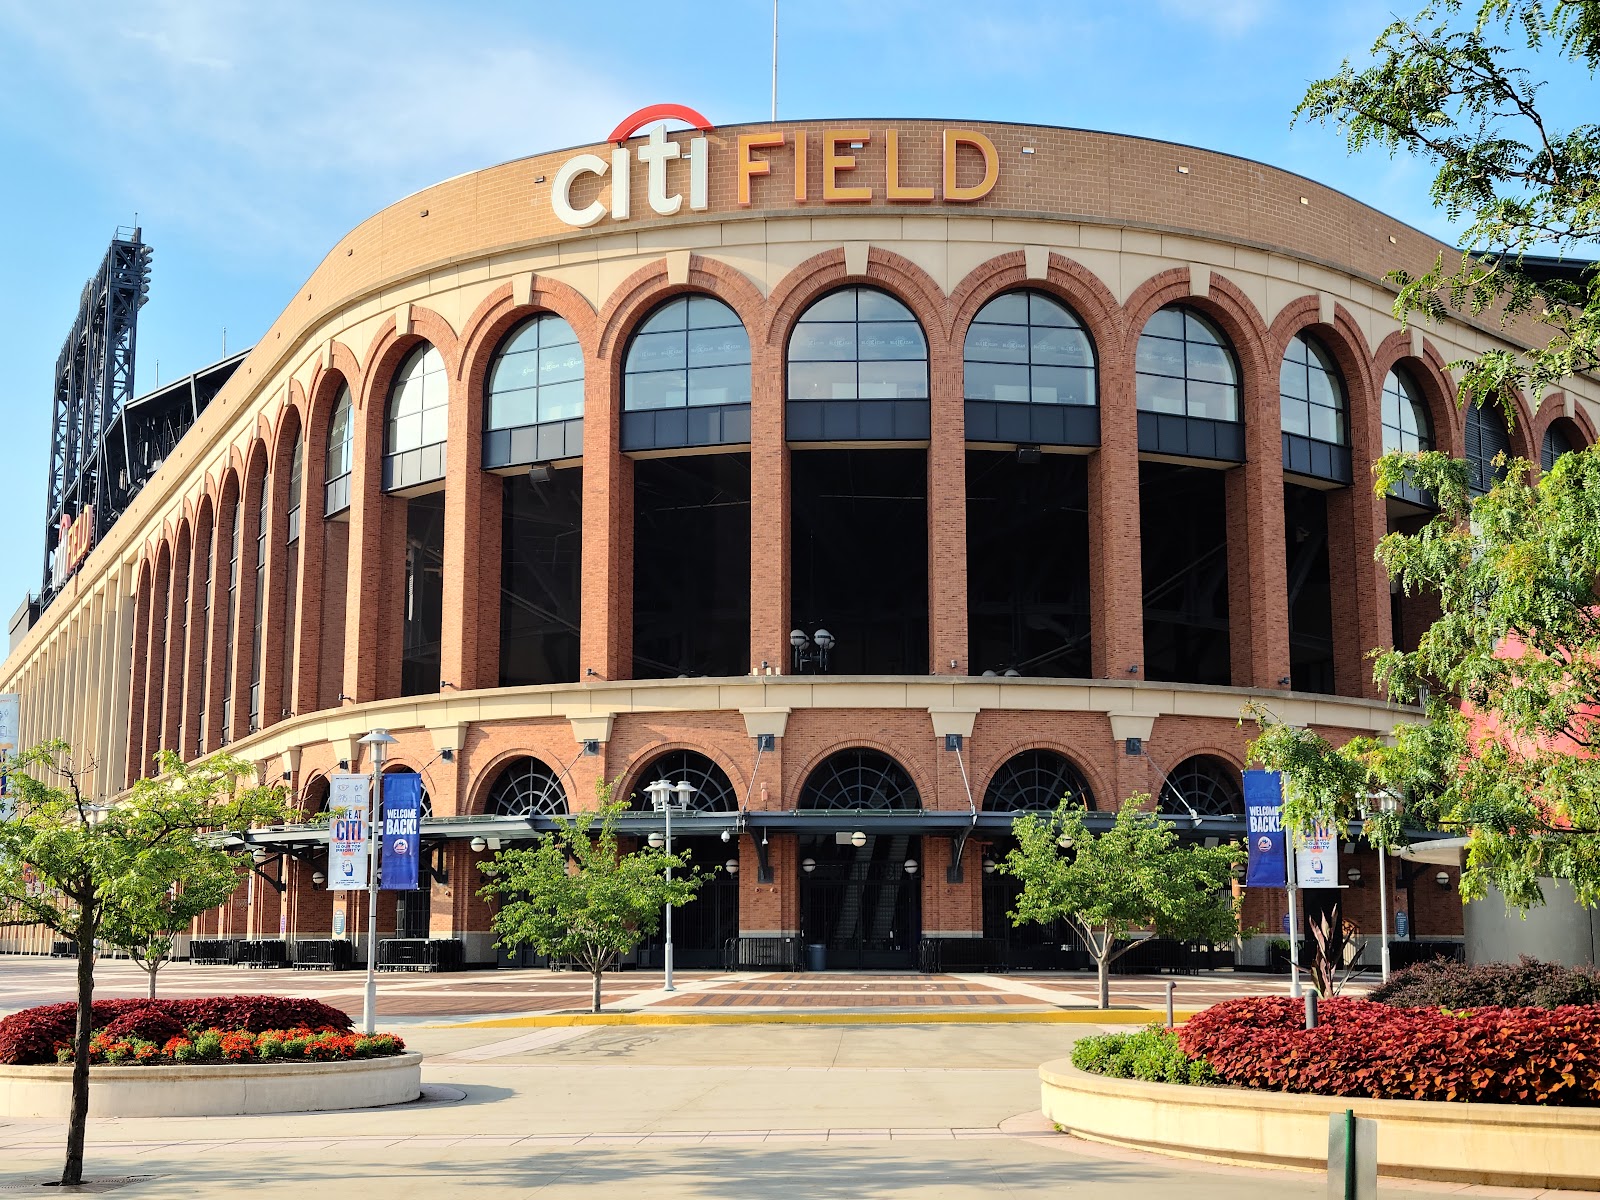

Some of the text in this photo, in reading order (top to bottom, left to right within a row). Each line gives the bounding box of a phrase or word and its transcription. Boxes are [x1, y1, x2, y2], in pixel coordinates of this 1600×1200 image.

[551, 123, 1000, 228] citi FIELD
[354, 809, 362, 820] AT
[387, 808, 417, 819] WELCOME
[1249, 805, 1280, 817] WELCOME
[336, 820, 362, 841] CITI
[386, 819, 418, 835] BACK!
[1249, 816, 1281, 833] BACK!
